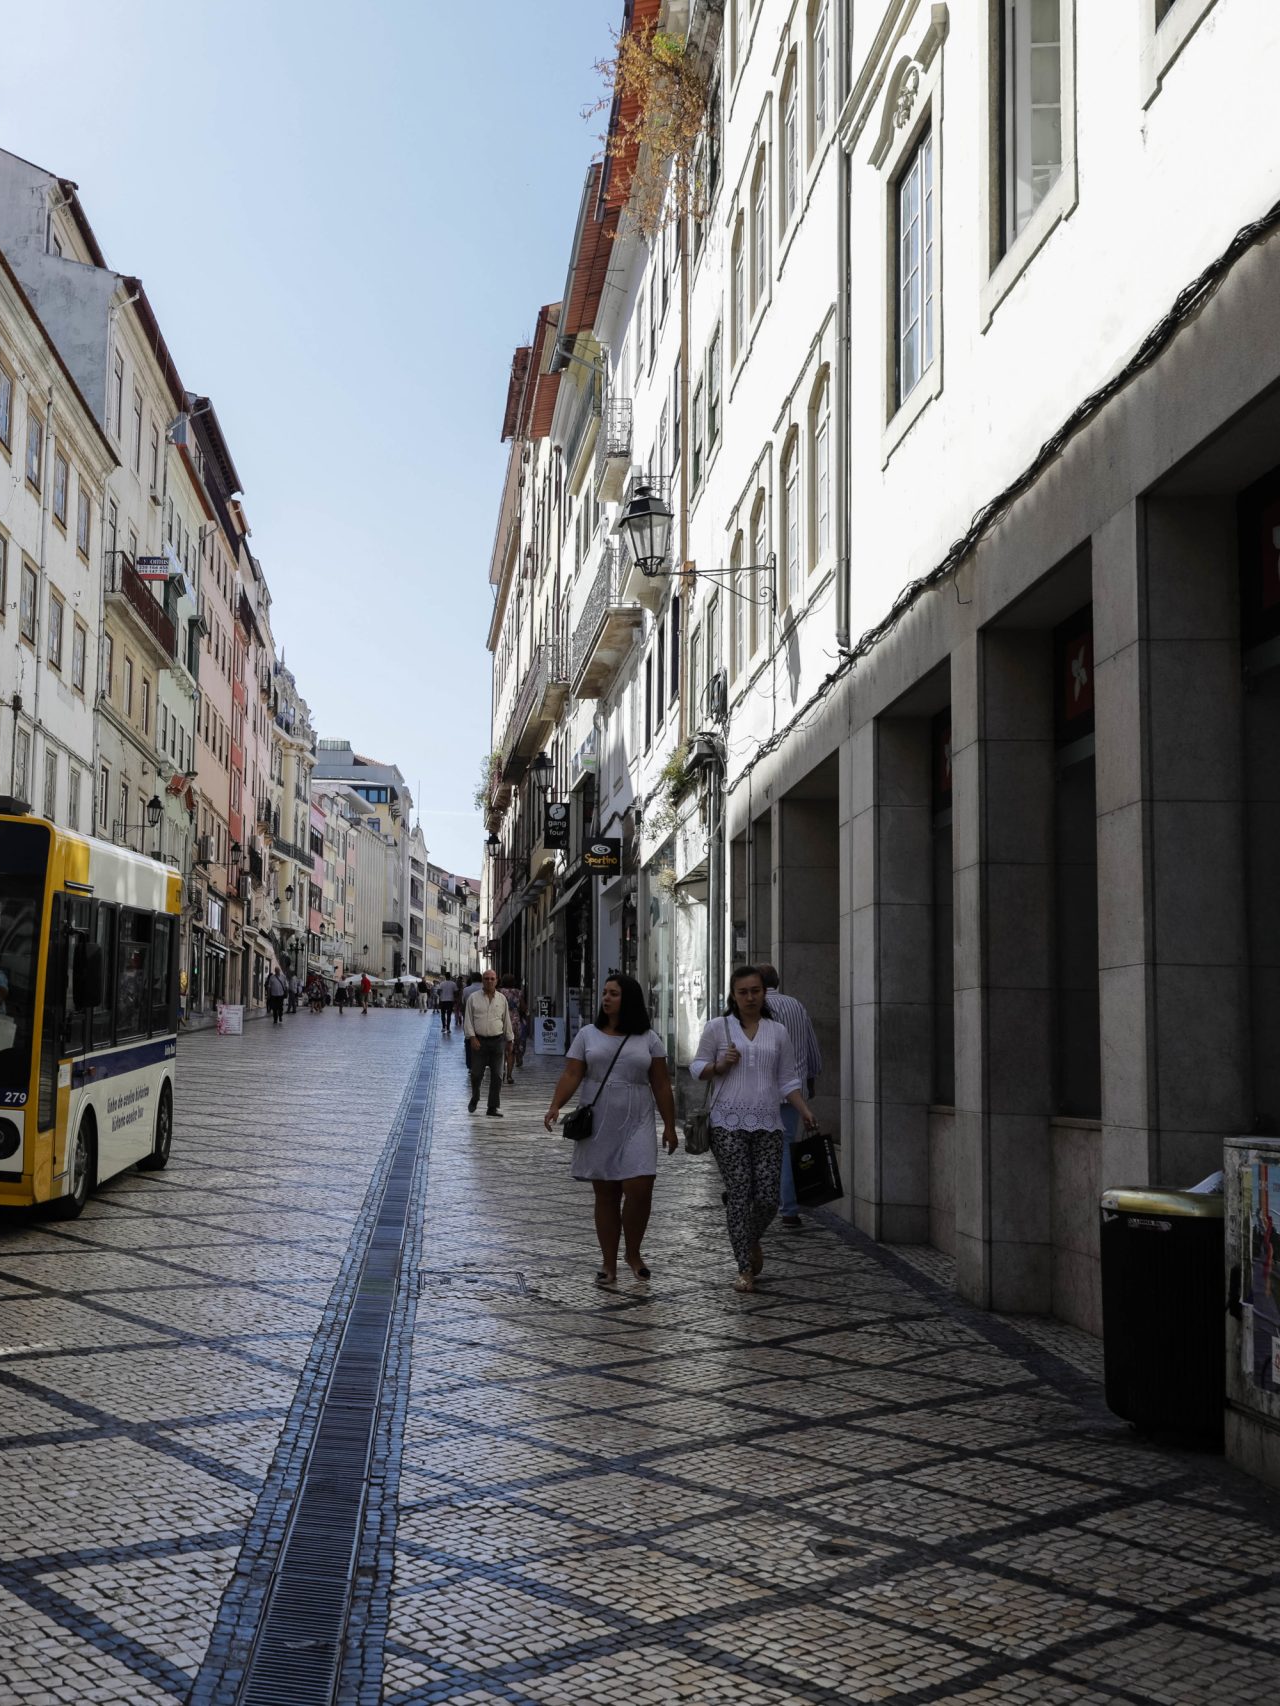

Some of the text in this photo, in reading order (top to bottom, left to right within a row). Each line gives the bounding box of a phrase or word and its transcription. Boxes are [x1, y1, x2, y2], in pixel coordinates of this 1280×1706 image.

[547, 820, 567, 828] gang
[584, 853, 618, 867] Sportino
[4, 1091, 28, 1104] 279
